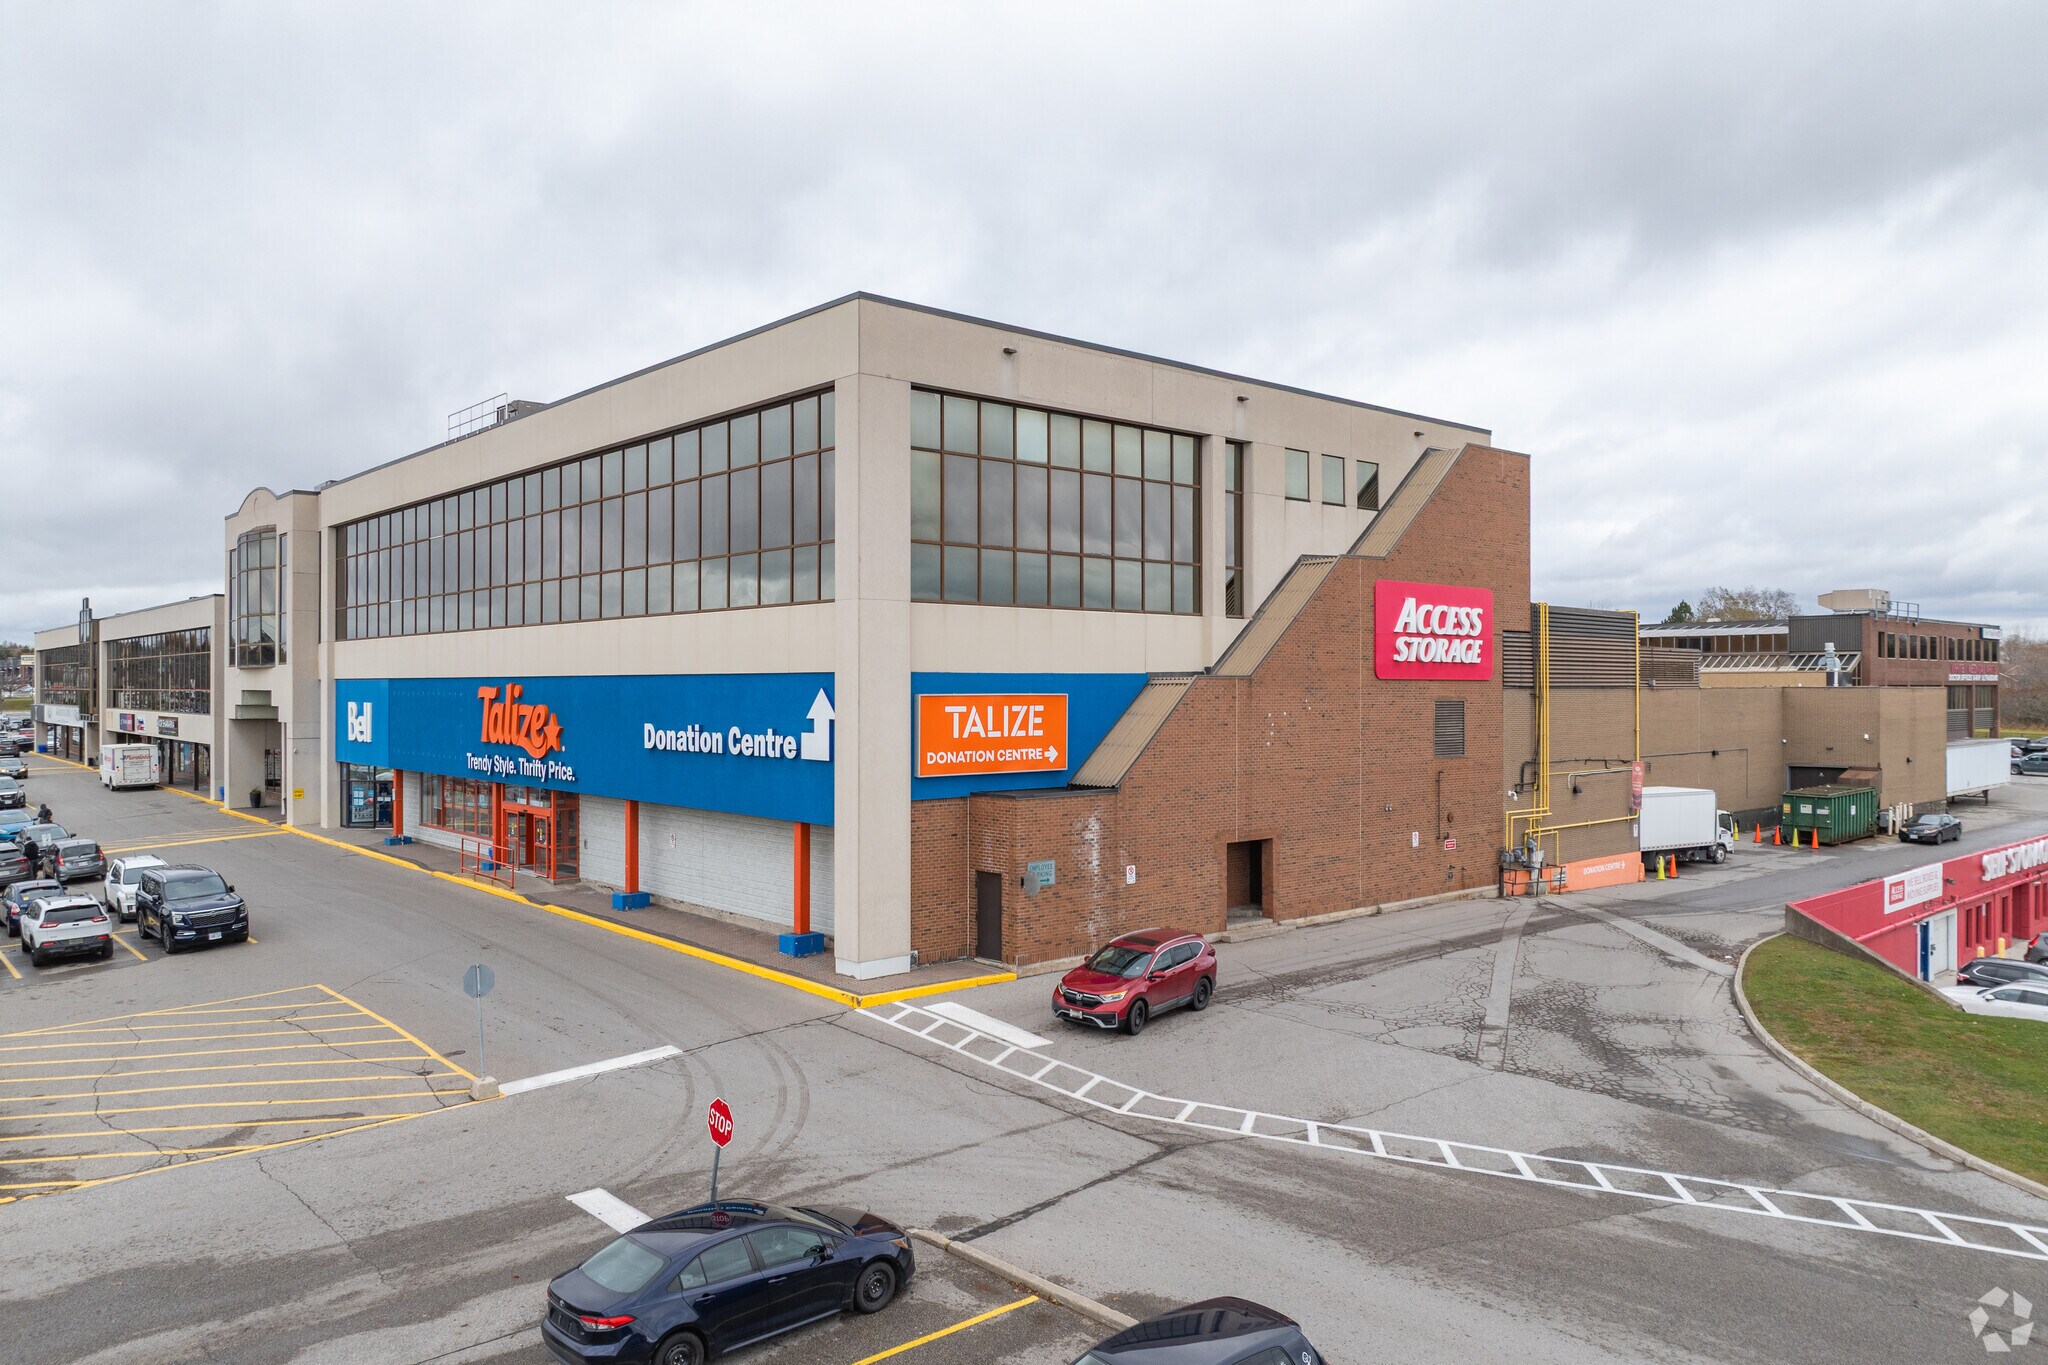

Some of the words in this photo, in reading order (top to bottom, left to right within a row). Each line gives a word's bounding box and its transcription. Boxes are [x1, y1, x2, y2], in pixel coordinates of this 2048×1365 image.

[1393, 597, 1484, 636] ACCESS
[1393, 636, 1484, 664] STORAGE
[347, 701, 373, 743] Bell
[478, 682, 549, 759] Talize
[944, 705, 1045, 738] TALIZE
[643, 722, 723, 754] Donation
[728, 726, 797, 760] Centre
[926, 750, 995, 764] DONATION
[997, 748, 1043, 761] CENTRE
[466, 752, 492, 776] Trendy
[493, 754, 517, 778] Style.
[518, 757, 547, 783] Thrifty
[548, 760, 576, 782] Price.
[1029, 862, 1053, 870] EMPLOYEE
[1583, 865, 1604, 874] DONATION
[1604, 862, 1621, 870] CENTRE
[1982, 852, 2008, 881] SELF
[709, 1107, 732, 1136] STOP
